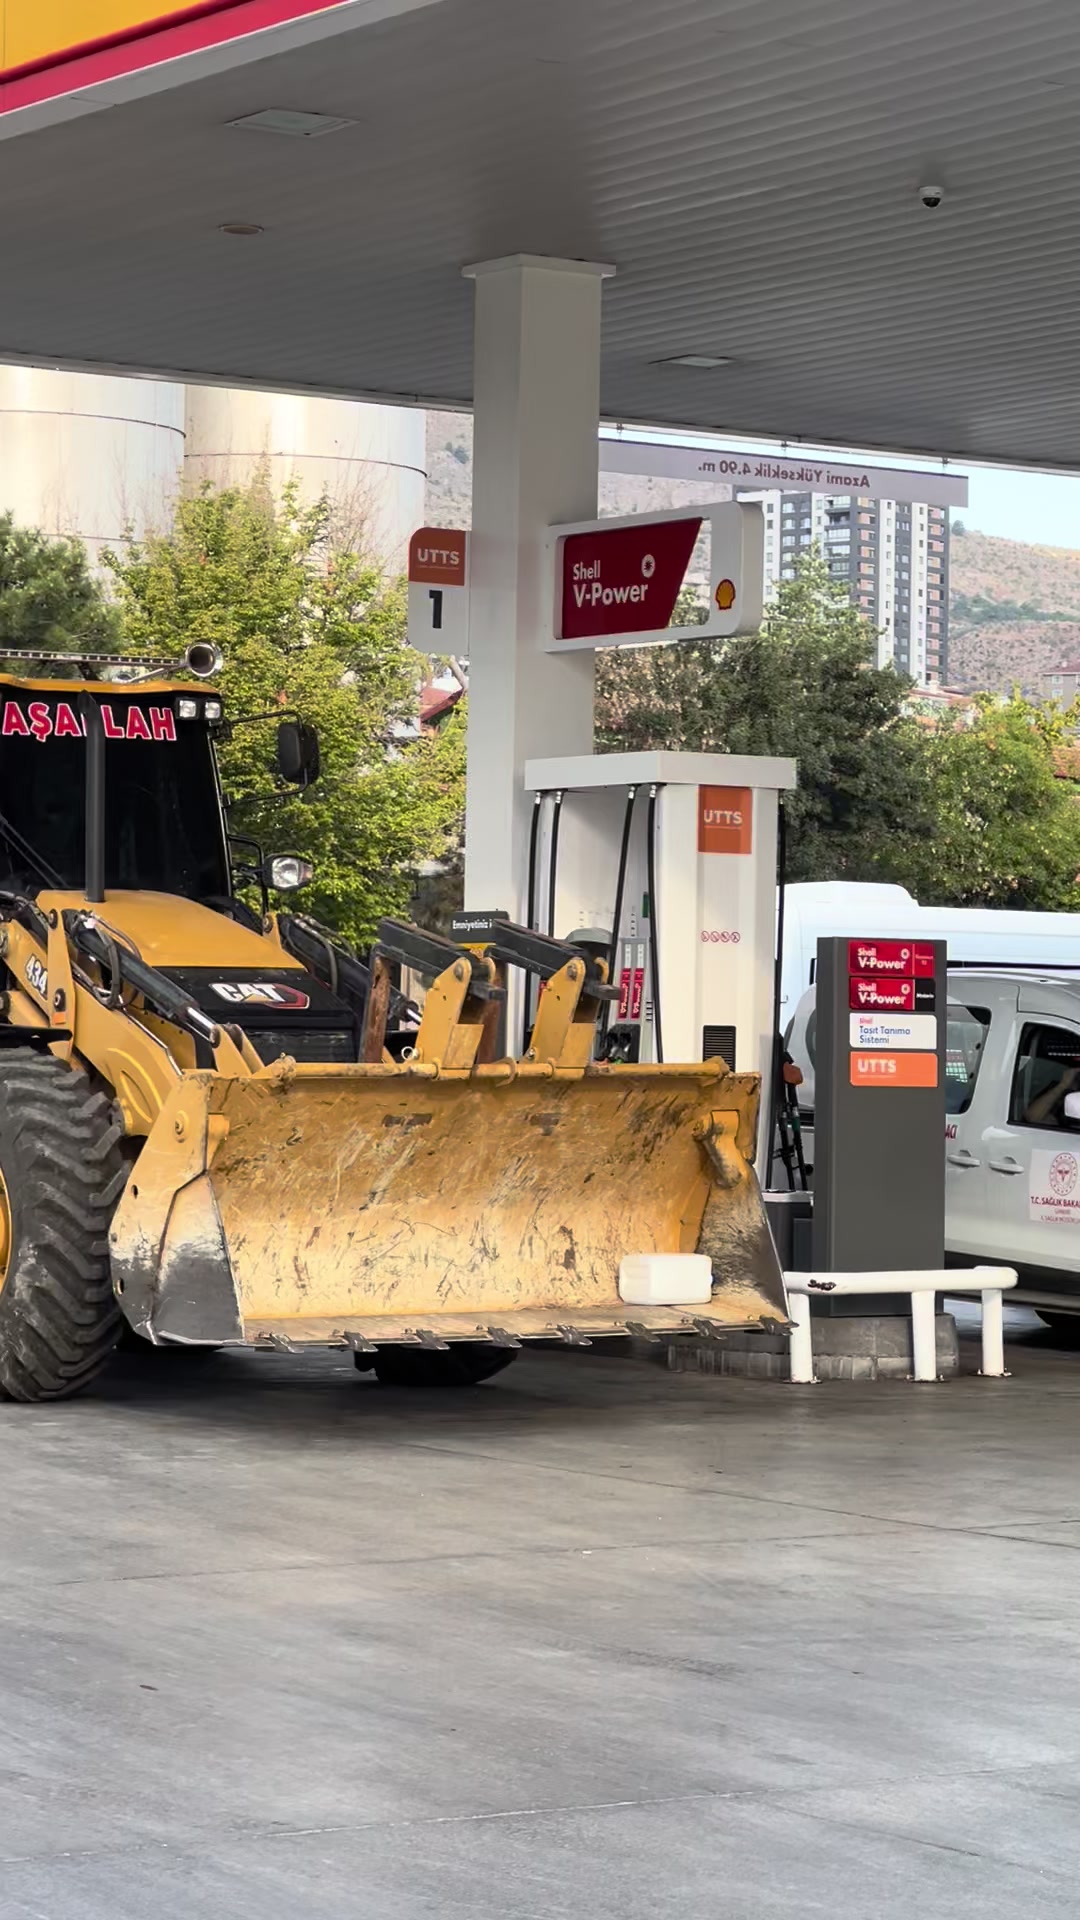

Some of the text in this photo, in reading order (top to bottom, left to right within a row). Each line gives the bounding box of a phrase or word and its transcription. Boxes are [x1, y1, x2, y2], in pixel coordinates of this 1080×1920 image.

[417, 548, 460, 565] UTTS
[573, 560, 600, 580] Shell
[573, 582, 648, 608] V-Power
[429, 589, 443, 629] 1
[703, 809, 743, 825] UTTS
[858, 956, 906, 969] V-Power
[210, 982, 286, 1003] CAT
[858, 991, 906, 1005] V-Power
[859, 1035, 890, 1044] Sistemi
[857, 1058, 897, 1073] UTTS
